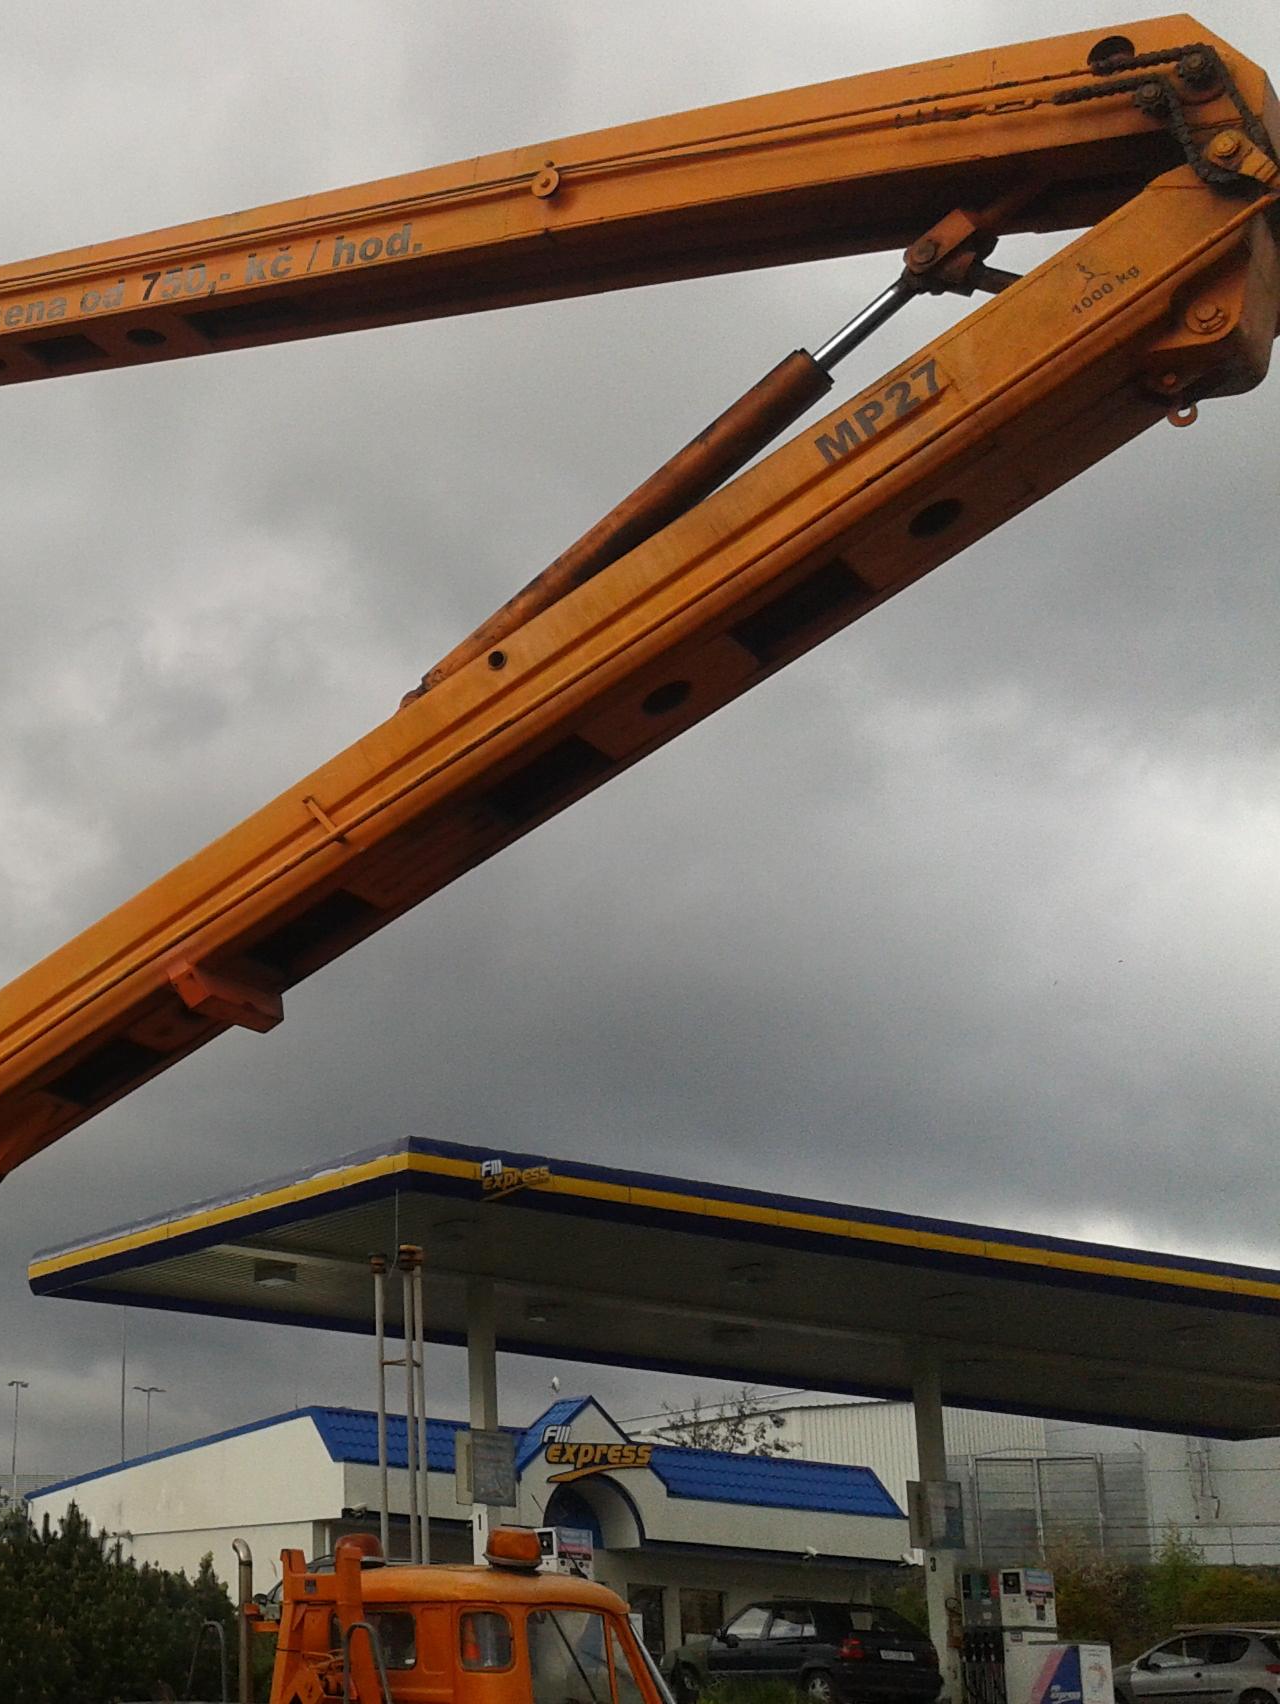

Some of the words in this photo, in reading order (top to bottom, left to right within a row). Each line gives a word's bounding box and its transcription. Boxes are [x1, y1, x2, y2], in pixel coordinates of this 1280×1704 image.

[79, 278, 126, 315] od
[245, 246, 292, 284] kč
[331, 223, 423, 269] hod.
[1071, 282, 1114, 316] 1000
[1115, 265, 1142, 287] kg
[814, 358, 942, 467] MP27
[545, 1443, 653, 1469] express
